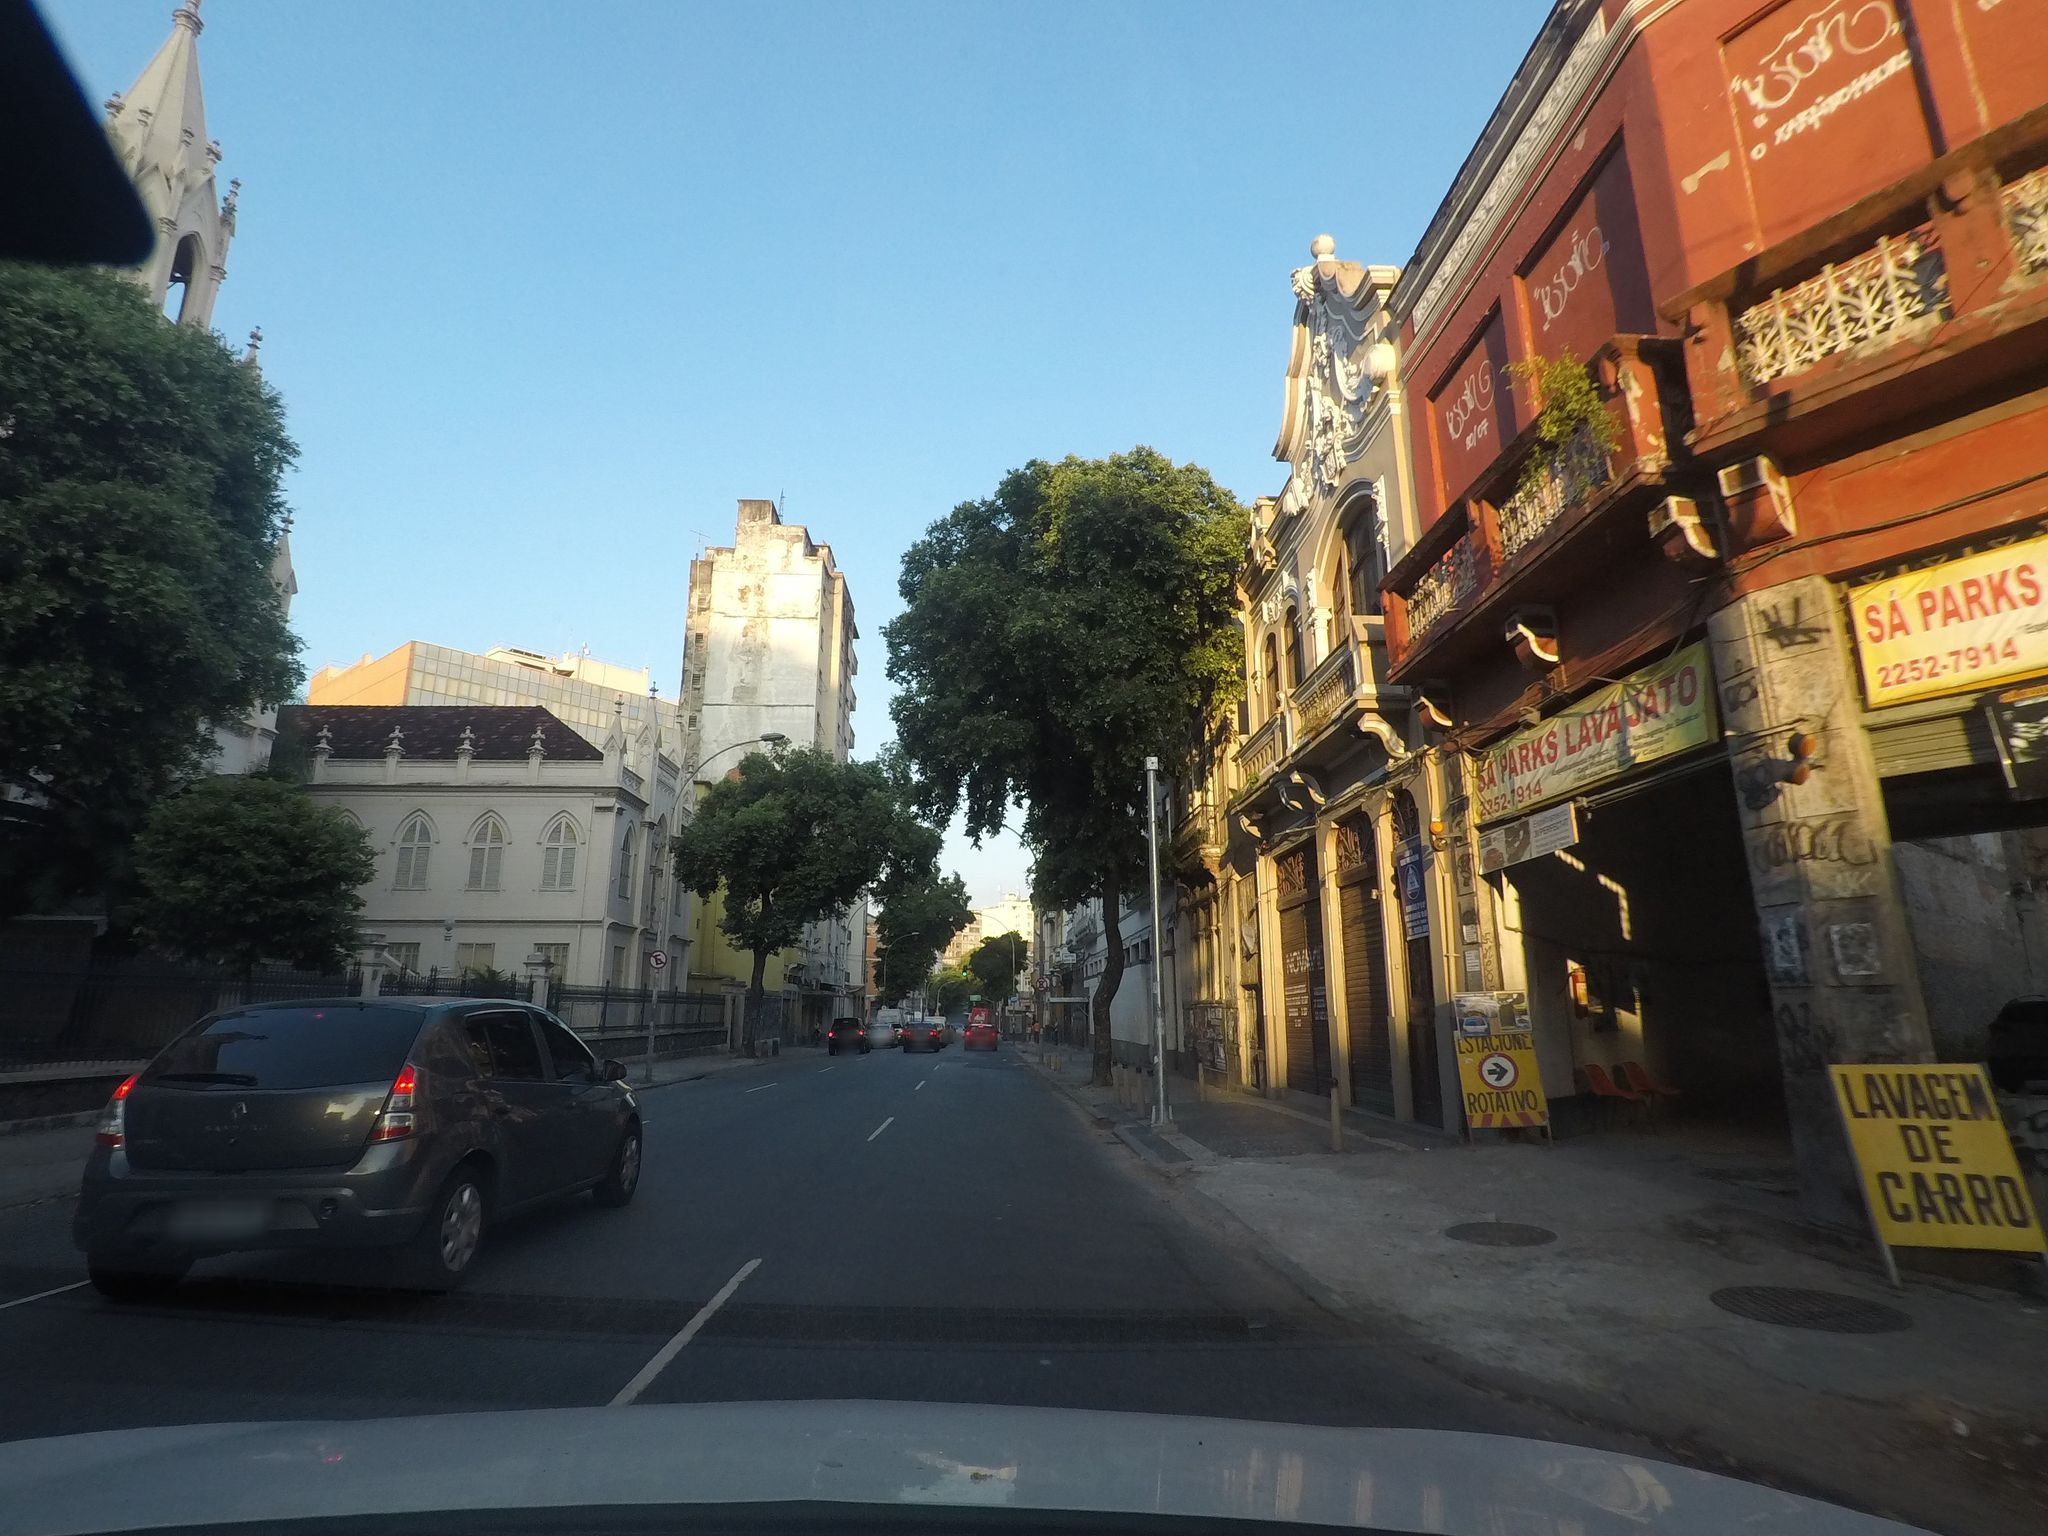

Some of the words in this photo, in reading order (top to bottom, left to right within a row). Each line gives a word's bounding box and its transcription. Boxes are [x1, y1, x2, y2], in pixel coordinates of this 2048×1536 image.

[1865, 590, 1911, 644] SÁ
[1917, 564, 2041, 631] PARKS
[1877, 637, 2020, 689] 2252-7914
[1499, 729, 1559, 784] PARKS
[1565, 700, 1622, 756] LAVA
[1625, 666, 1698, 728] JATO
[1466, 1089, 1538, 1114] ROTATIVO
[1840, 1073, 1997, 1122] LAVAGEM
[1898, 1124, 1962, 1164] DE
[1876, 1171, 2032, 1229] CARRO
